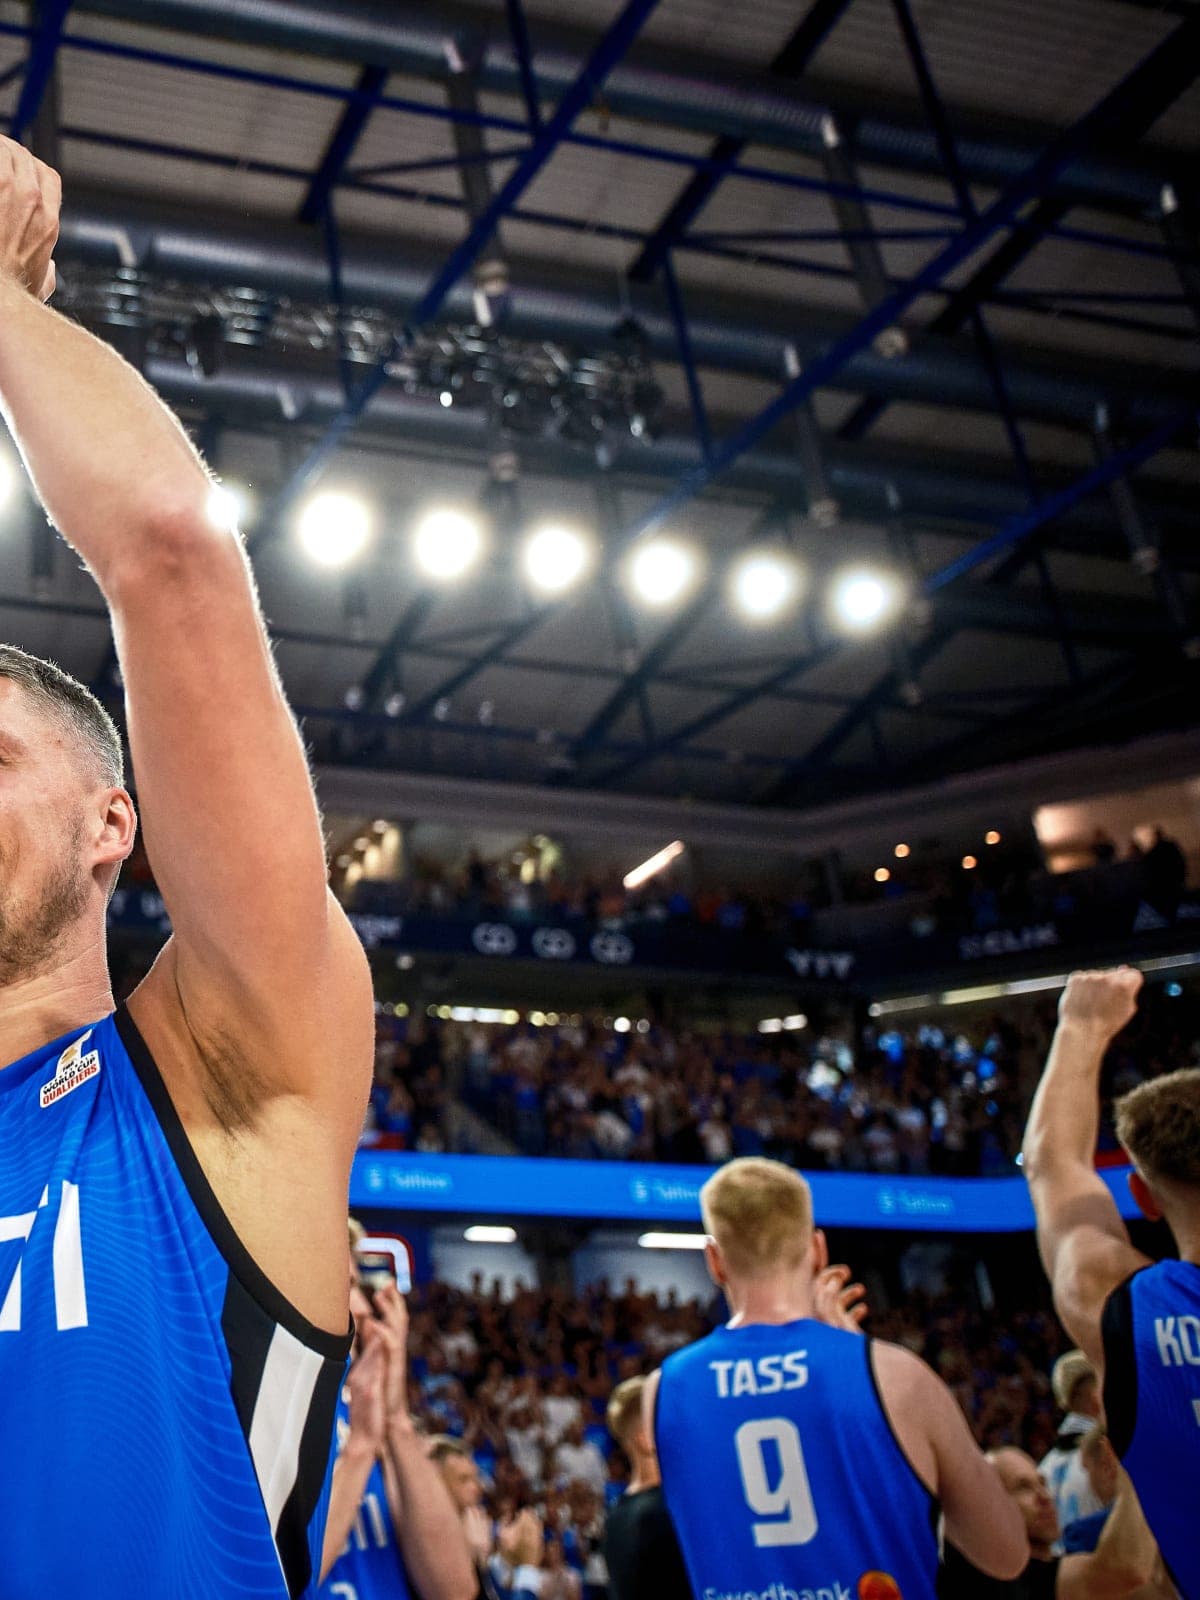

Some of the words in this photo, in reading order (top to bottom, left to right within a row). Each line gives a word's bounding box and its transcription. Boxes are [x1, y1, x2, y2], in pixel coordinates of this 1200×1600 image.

[42, 1071, 76, 1094] WORLD
[76, 1056, 96, 1072] CUP
[42, 1064, 98, 1105] QUALIFIERS
[709, 1350, 809, 1398] TASS
[735, 1416, 819, 1547] 9
